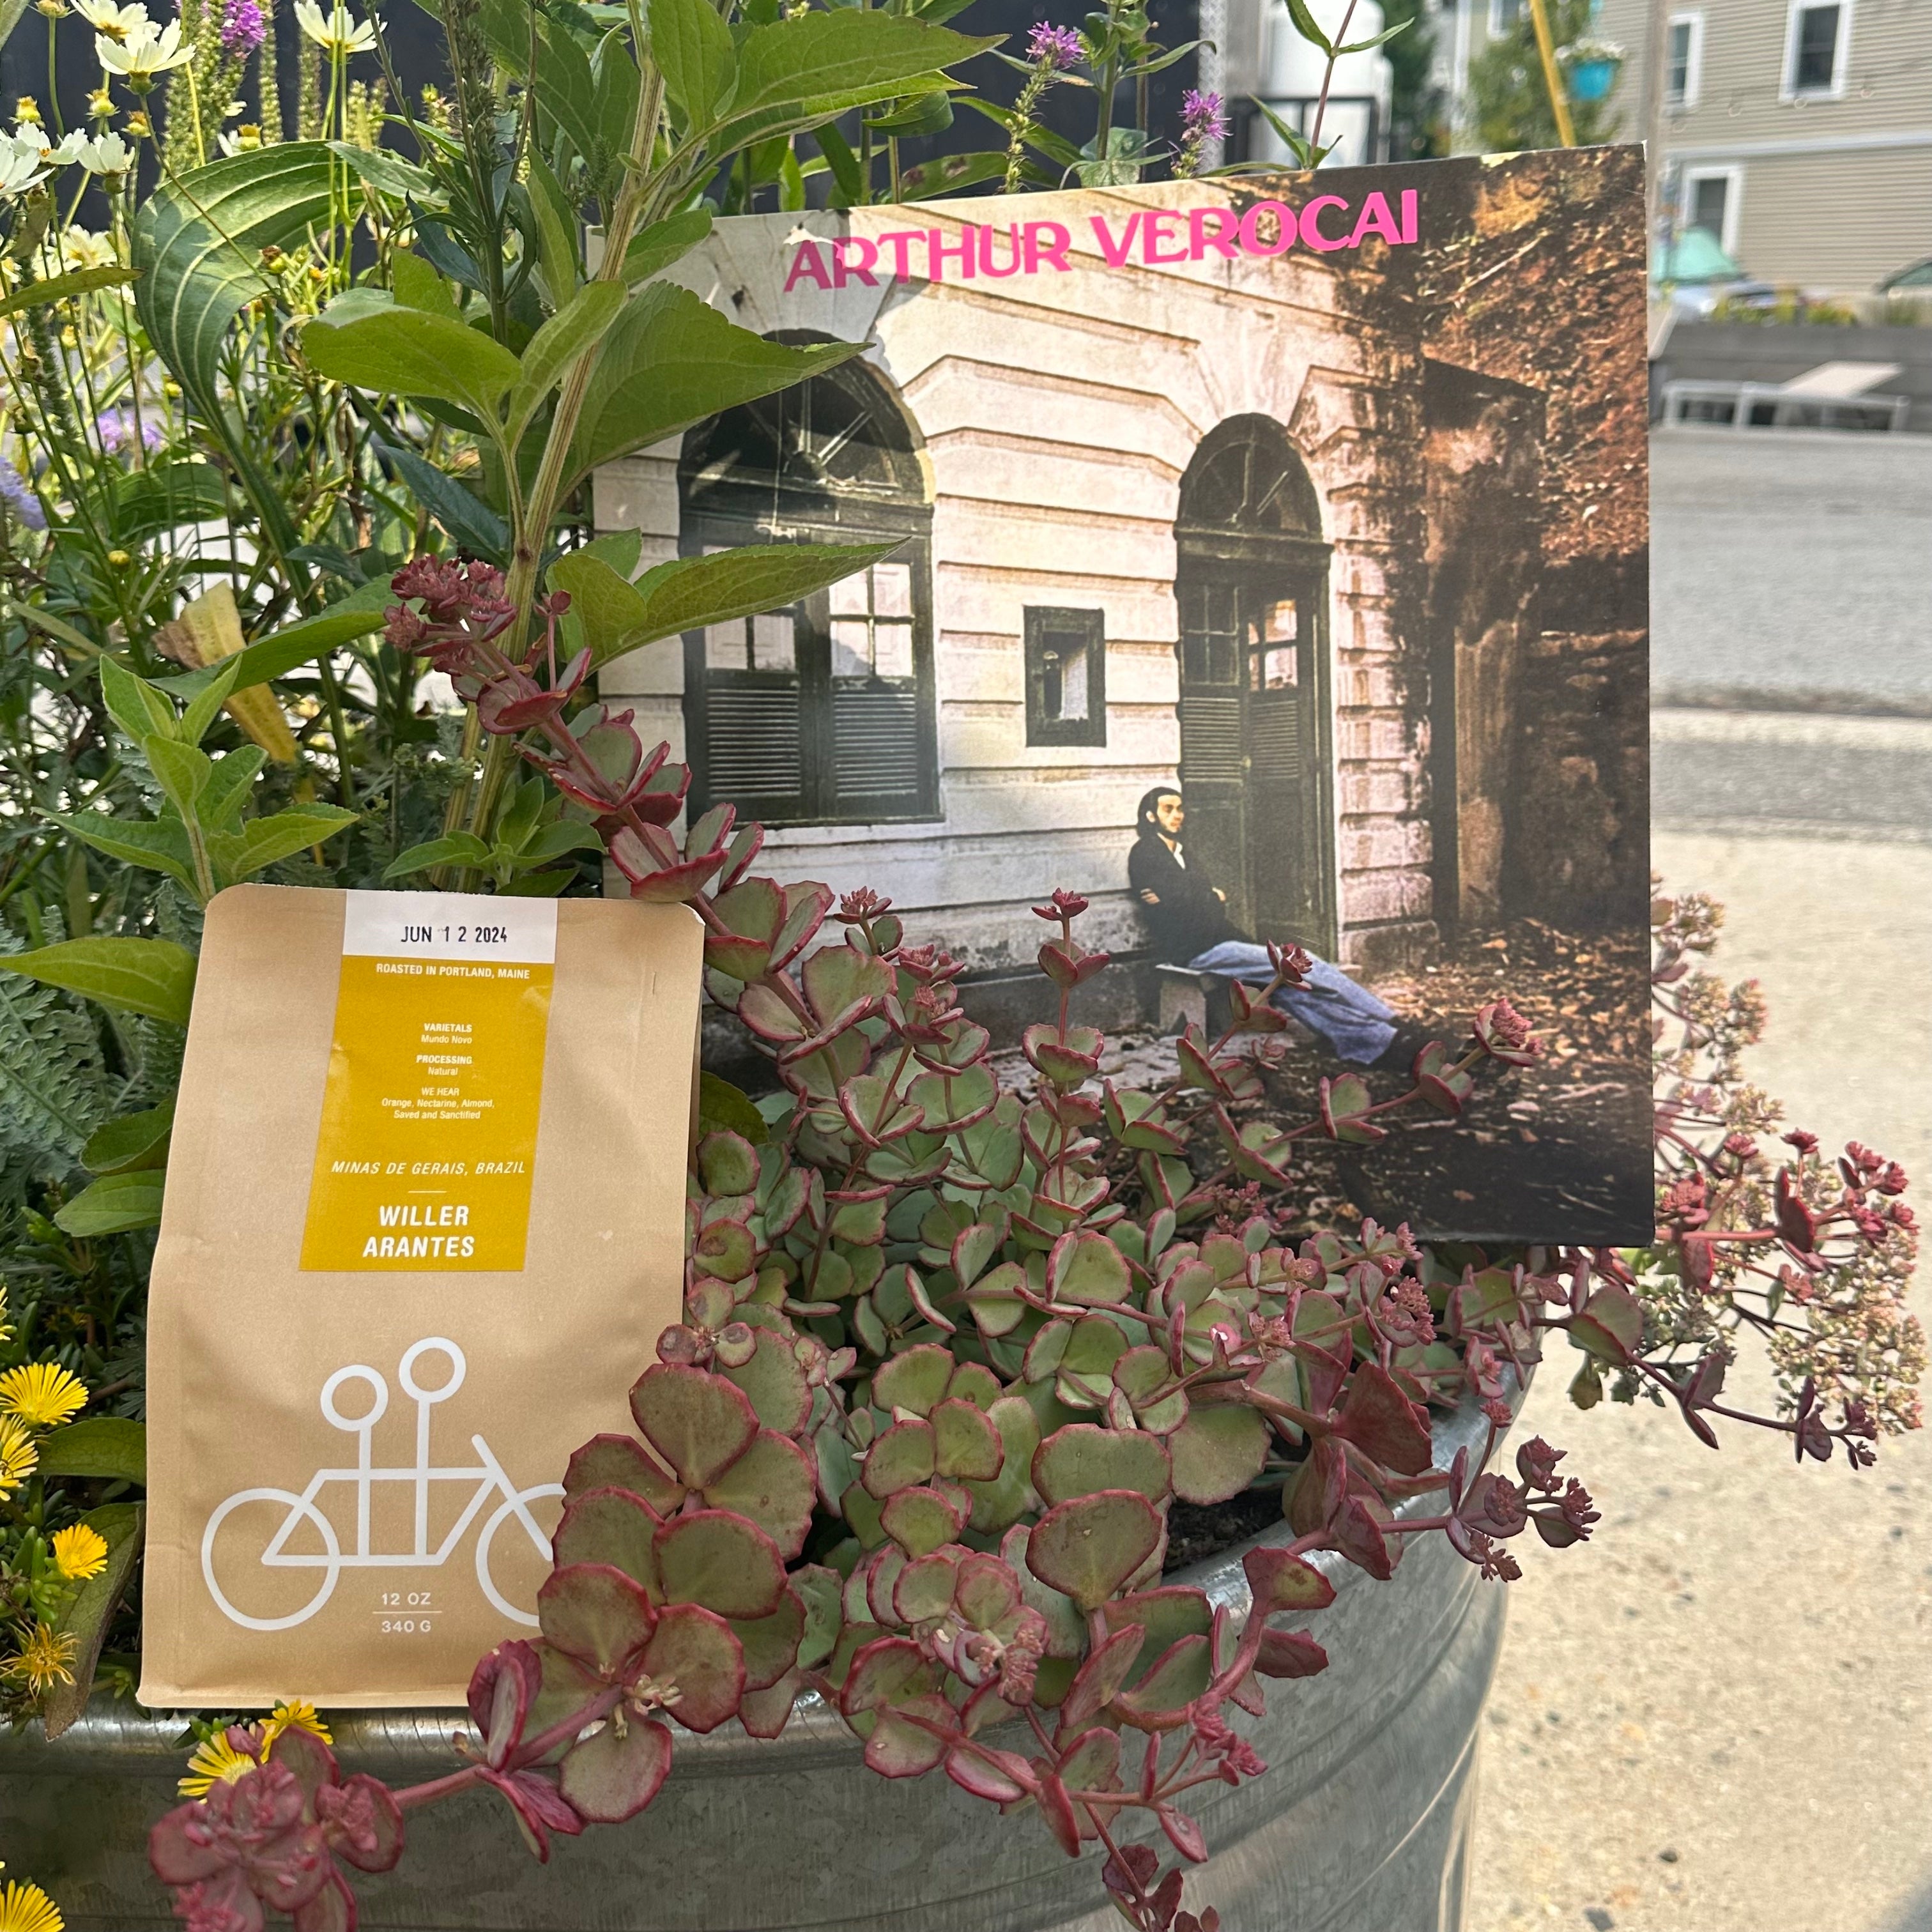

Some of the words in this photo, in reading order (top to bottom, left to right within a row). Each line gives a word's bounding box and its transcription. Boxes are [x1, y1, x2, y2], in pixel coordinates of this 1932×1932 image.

[783, 220, 1073, 294] ARTHUR
[1089, 188, 1418, 269] VEROCAI
[401, 926, 433, 943] JUN
[475, 926, 508, 943] 2024
[376, 963, 422, 975] ROASTED
[425, 965, 437, 976] IN
[439, 966, 495, 979] PORTLAND,
[498, 969, 530, 979] MAINE
[424, 1023, 472, 1033] VARIETALS
[421, 1034, 449, 1045] Mundo
[451, 1035, 473, 1045] Novo
[416, 1054, 473, 1065] PROCESSING
[427, 1066, 458, 1076] Natural
[421, 1087, 435, 1096] WE
[436, 1087, 460, 1096] HEAR
[381, 1098, 415, 1109] Orange,
[417, 1098, 459, 1109] Nectarine,
[461, 1099, 495, 1109] Almond,
[394, 1110, 420, 1119] Saved
[422, 1110, 437, 1119] and
[440, 1110, 481, 1120] Sanctified
[331, 1160, 381, 1174] MINAS
[385, 1162, 407, 1174] DE
[411, 1162, 469, 1177] GERAIS,
[475, 1162, 526, 1174] BRAZIL
[379, 1205, 470, 1227] WILLER
[362, 1236, 475, 1258] ARANTES
[381, 1592, 401, 1606] 12
[407, 1591, 431, 1605] OZ
[381, 1620, 415, 1633] 340
[419, 1620, 432, 1633] G
